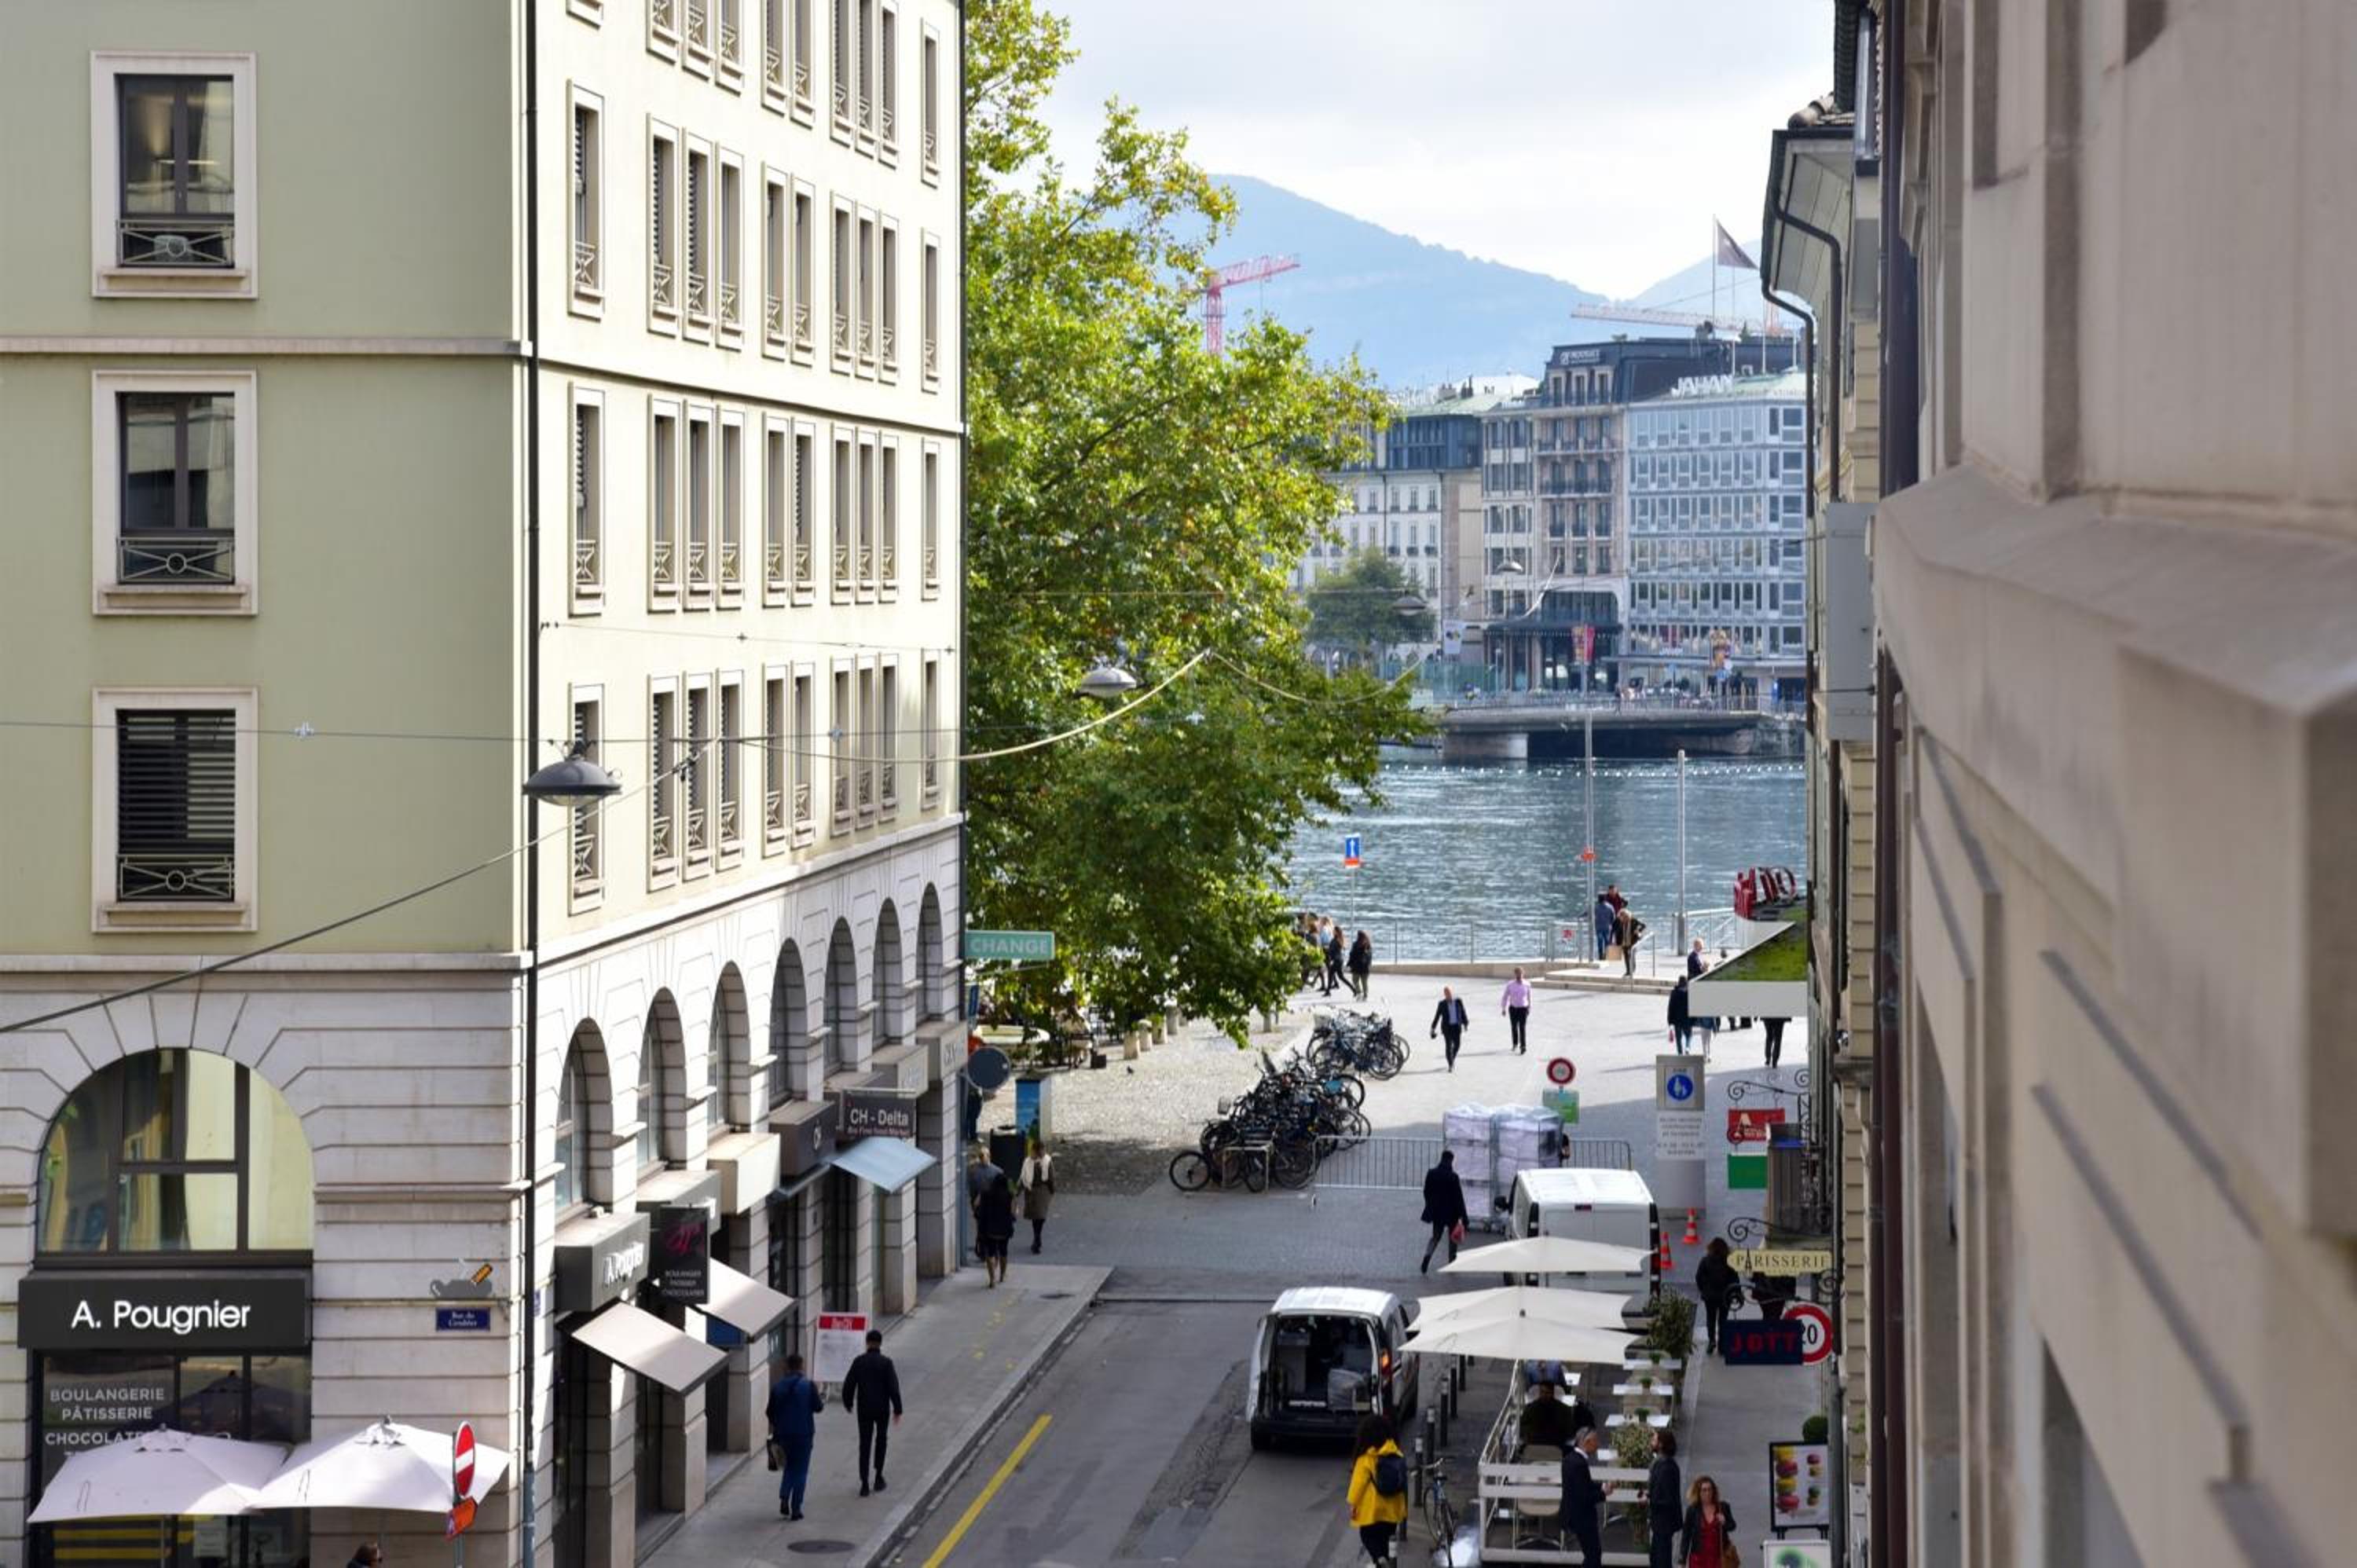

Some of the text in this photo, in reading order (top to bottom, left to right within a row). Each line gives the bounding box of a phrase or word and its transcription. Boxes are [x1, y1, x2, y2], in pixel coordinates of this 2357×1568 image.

[1670, 374, 1733, 399] JAHAN
[970, 936, 1048, 954] CHANGE
[849, 1108, 868, 1125] CH
[878, 1108, 909, 1126] Delta
[71, 1299, 251, 1335] A. Pougnier
[1731, 1332, 1798, 1355] JOTT
[49, 1387, 164, 1403] BOULANGERIE
[62, 1404, 152, 1420] PÂTISSERIE
